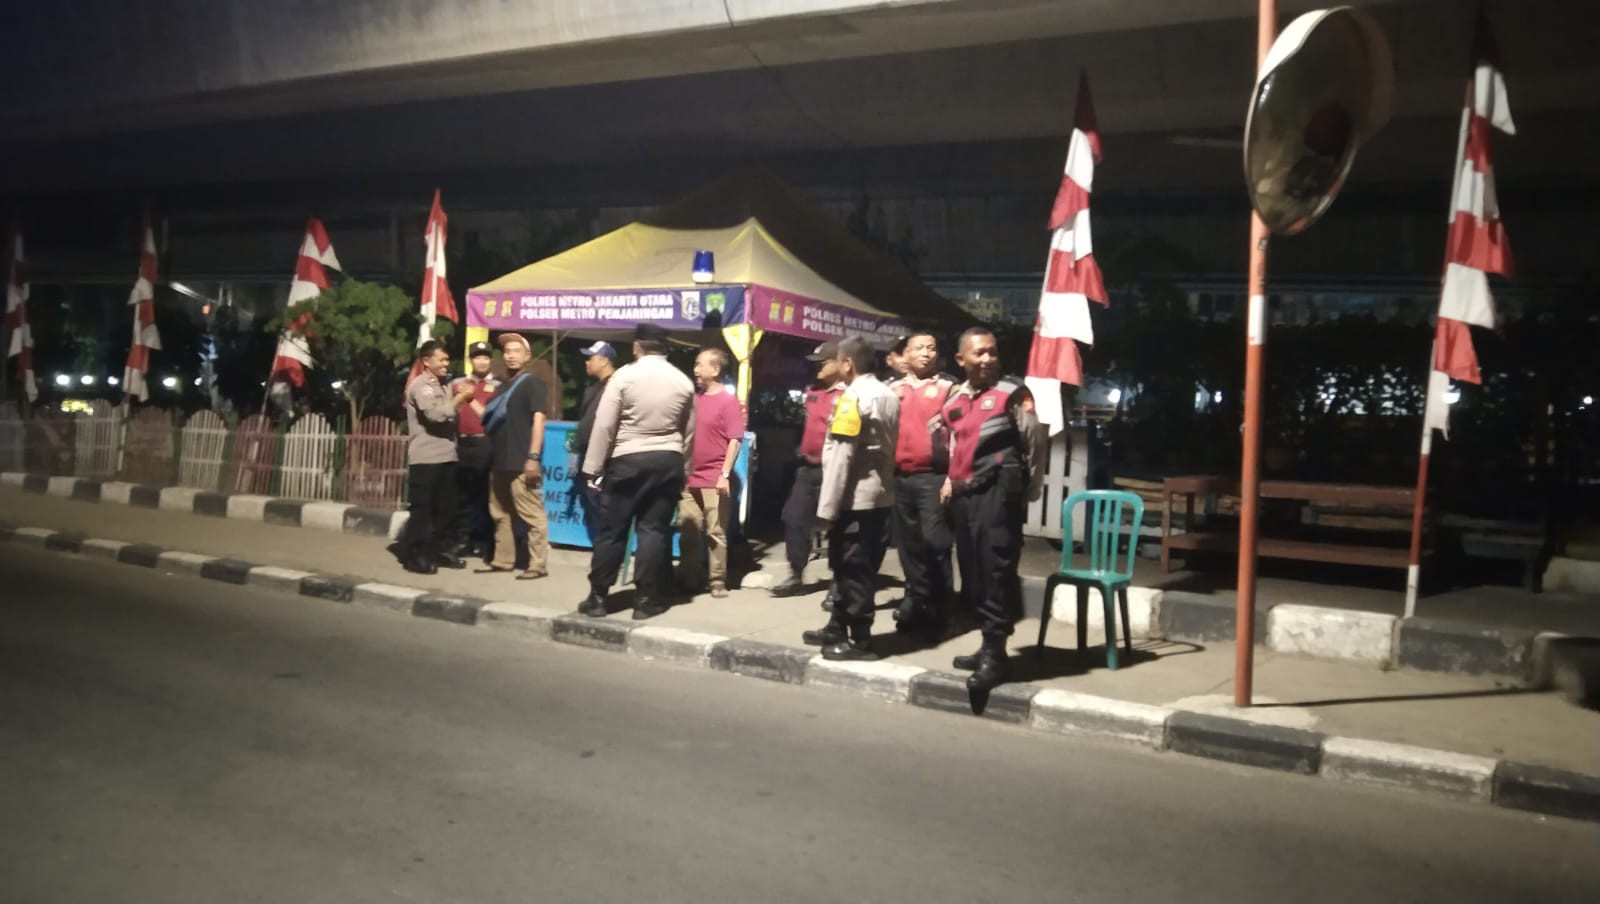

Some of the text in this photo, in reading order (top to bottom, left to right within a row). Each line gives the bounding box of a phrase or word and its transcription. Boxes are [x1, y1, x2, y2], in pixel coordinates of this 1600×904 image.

[520, 294, 674, 307] POLRES METRO JAKARTA UTARA
[520, 307, 674, 320] POLSEK METRO PENJARINGAN
[802, 305, 842, 324] POLRES
[801, 318, 844, 337] POLSEK
